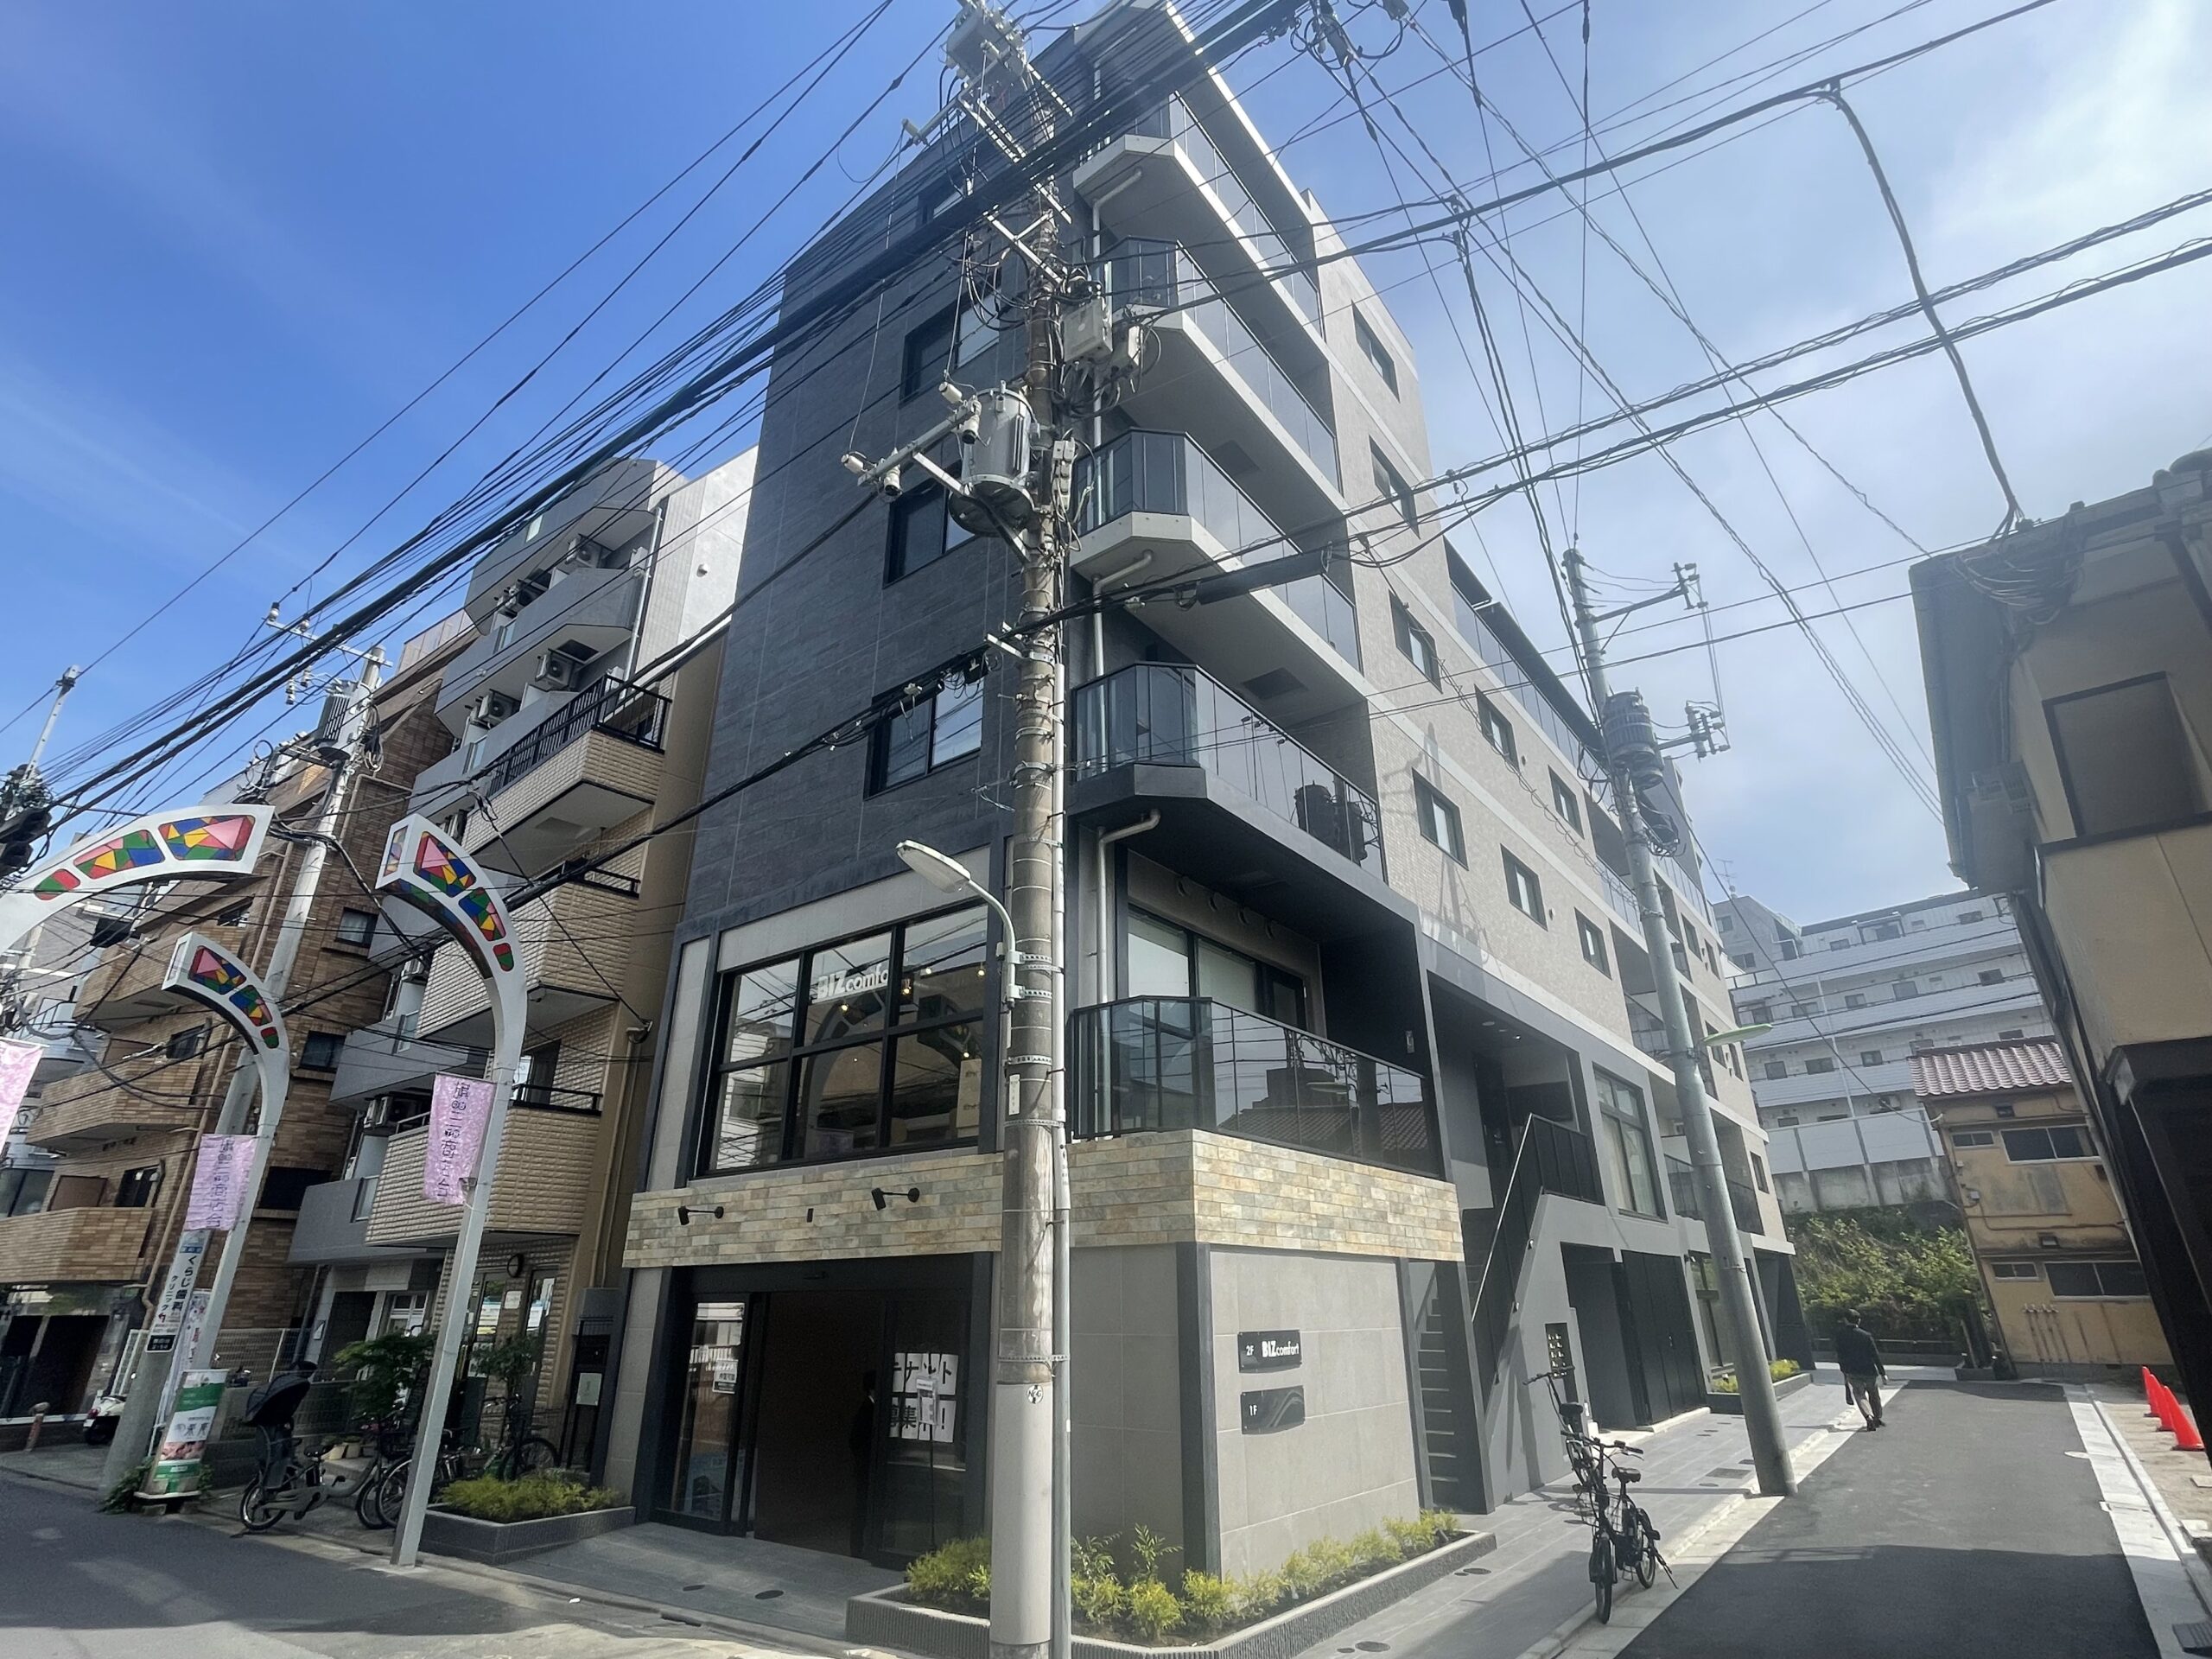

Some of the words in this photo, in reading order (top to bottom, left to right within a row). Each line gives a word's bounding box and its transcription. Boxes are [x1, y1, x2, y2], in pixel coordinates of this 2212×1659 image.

[1246, 1344, 1255, 1357] 2F
[1262, 1340, 1300, 1357] BIZcomfort
[1249, 1405, 1258, 1416] 1F
